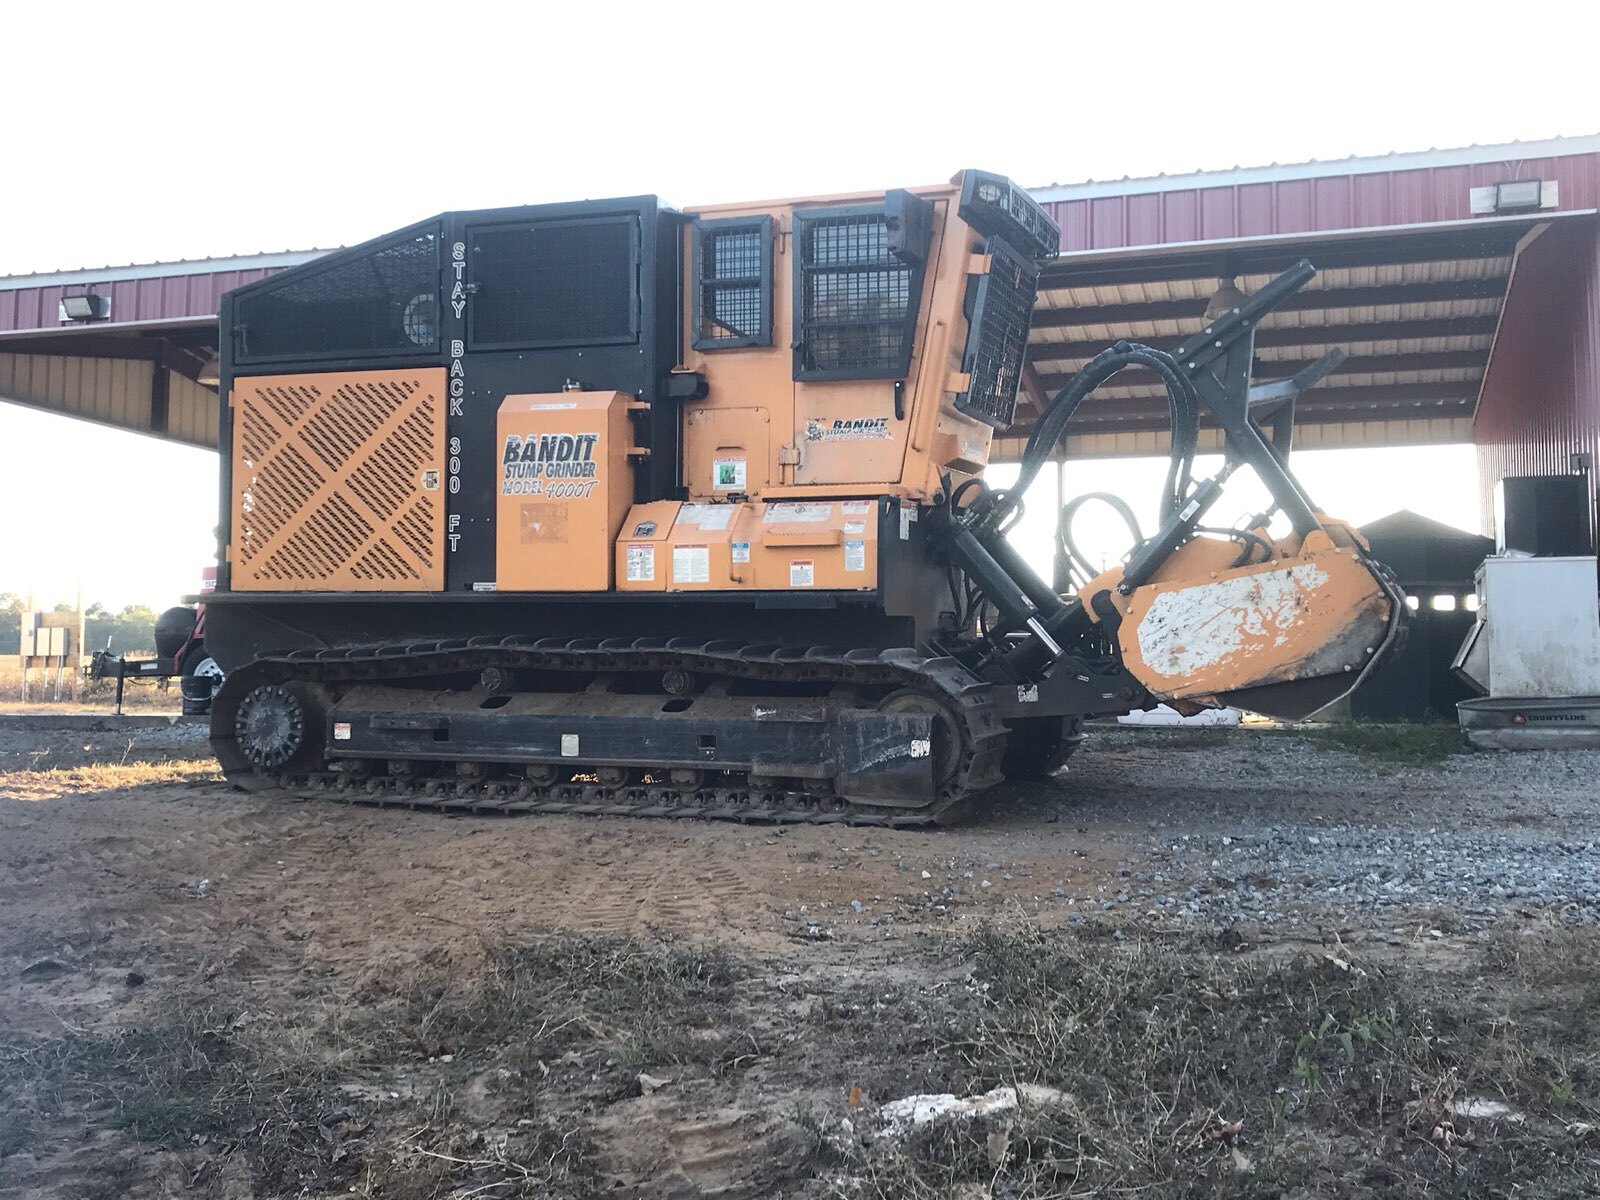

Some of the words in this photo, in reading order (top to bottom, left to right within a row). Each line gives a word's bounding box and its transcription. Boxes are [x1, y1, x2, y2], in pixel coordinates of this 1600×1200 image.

[451, 241, 466, 319] STAY
[450, 339, 465, 416] BACK
[833, 417, 888, 430] BANDIT
[449, 436, 461, 494] 300
[502, 433, 598, 465] BANDIT
[505, 462, 543, 479] STUMP
[545, 461, 596, 478] GRINDER
[502, 480, 542, 494] MODEL
[546, 480, 598, 498] 4000T
[448, 514, 461, 552] FT
